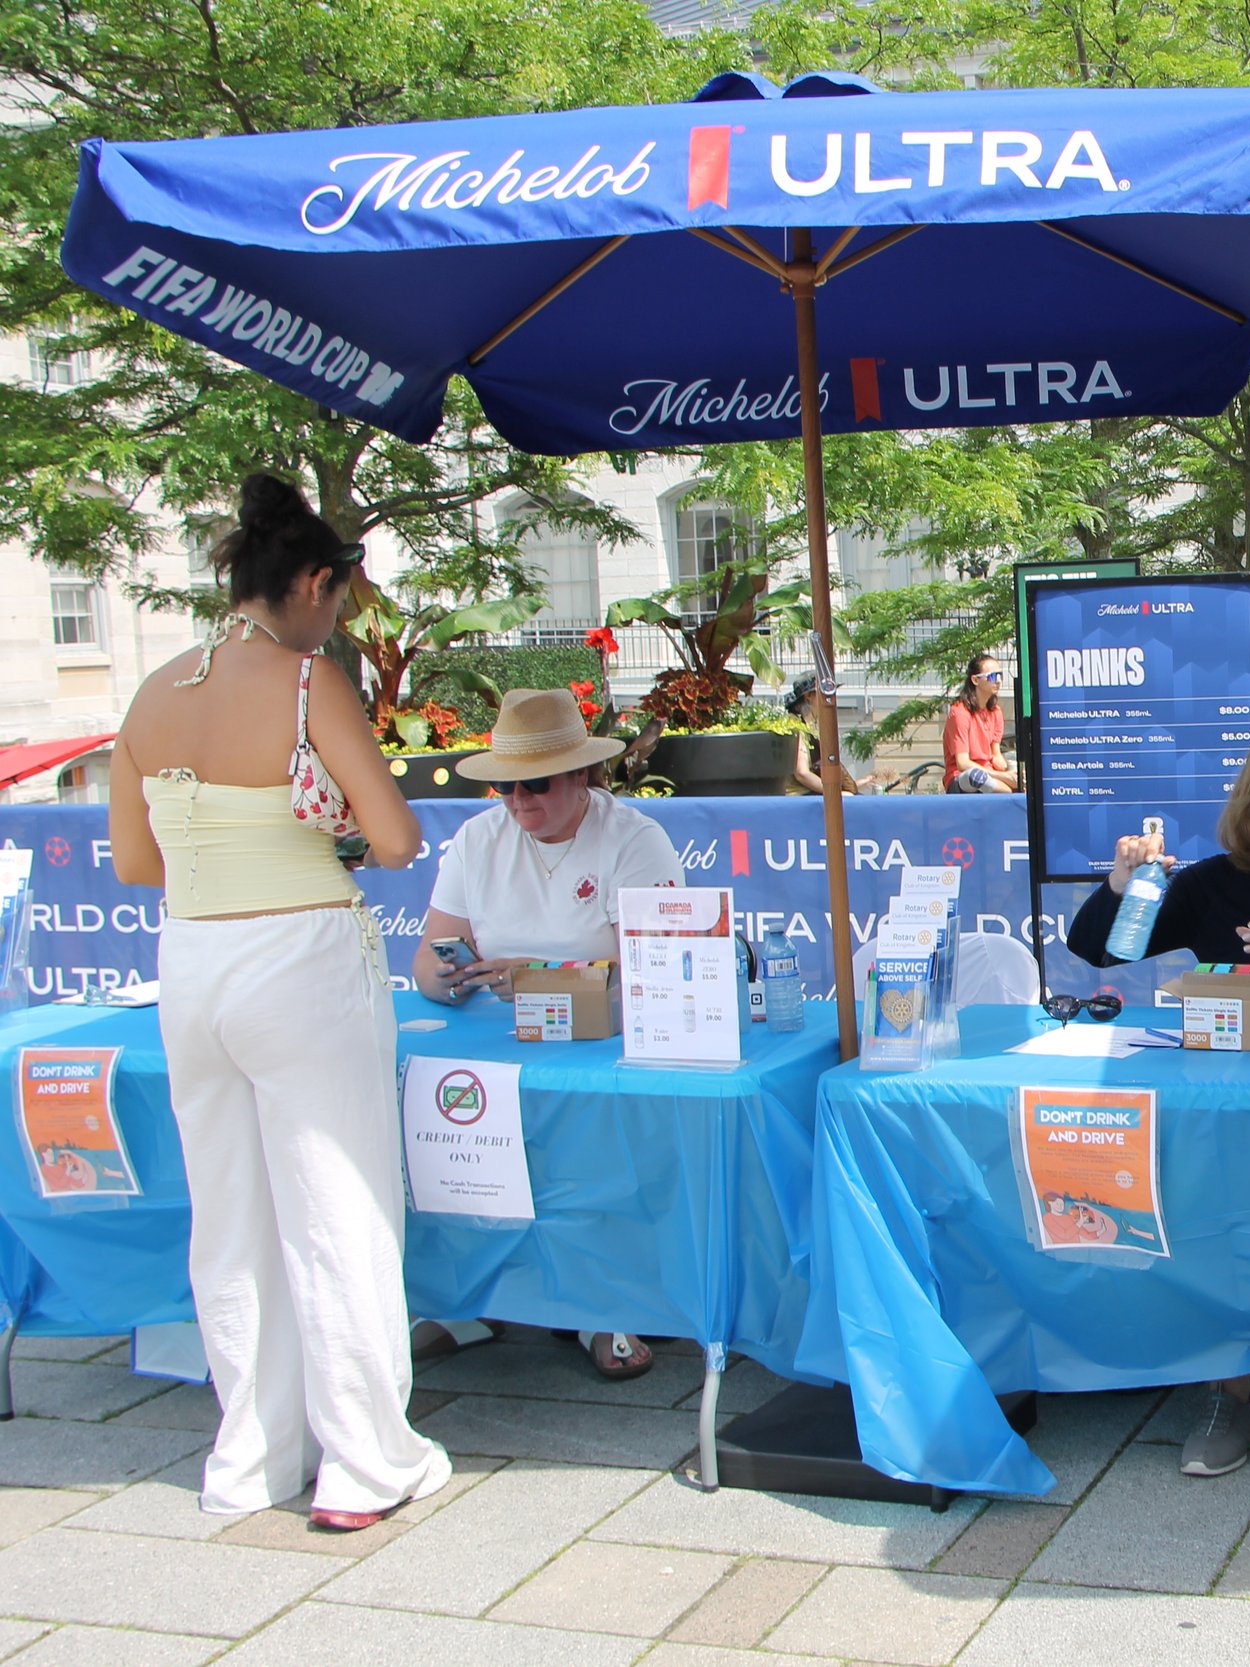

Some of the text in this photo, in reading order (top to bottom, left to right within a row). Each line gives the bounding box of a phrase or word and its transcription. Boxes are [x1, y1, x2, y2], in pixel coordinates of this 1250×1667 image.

[301, 130, 1121, 234] Michelob ULTRA
[102, 245, 217, 317] FIFA
[201, 284, 322, 365] WORLD
[311, 335, 370, 390] CUP
[903, 360, 1125, 412] ULTRA
[1097, 602, 1194, 617] Michelob ULTRA
[1046, 647, 1145, 688] DRINKS
[1049, 710, 1088, 719] Michelob
[1088, 709, 1120, 718] ULTRA
[1219, 706, 1250, 715] $8.00
[1050, 736, 1089, 745] Michelob
[1089, 735, 1121, 744] ULTRA
[1121, 735, 1143, 743] Zero
[1221, 732, 1250, 741] $5.00
[1051, 761, 1076, 770] Stella
[1076, 761, 1104, 769] Artois
[764, 839, 913, 870] ULRA
[917, 874, 940, 883] Rotary
[904, 904, 928, 913] Rotary
[30, 903, 166, 934] RLD CU
[892, 933, 916, 942] Rotary
[879, 962, 928, 973] SERVICE
[878, 974, 923, 982] ABOVE SELF
[1186, 1033, 1207, 1042] 3000
[32, 1065, 96, 1078] DON'T DRINK
[37, 1082, 90, 1094] AND DRIVE
[1040, 1109, 1131, 1126] DON'T DRINK
[416, 1131, 464, 1145] CREDIT
[474, 1136, 513, 1148] DEBIT
[1048, 1131, 1125, 1145] AND DRIVE
[449, 1152, 483, 1164] ONLY
